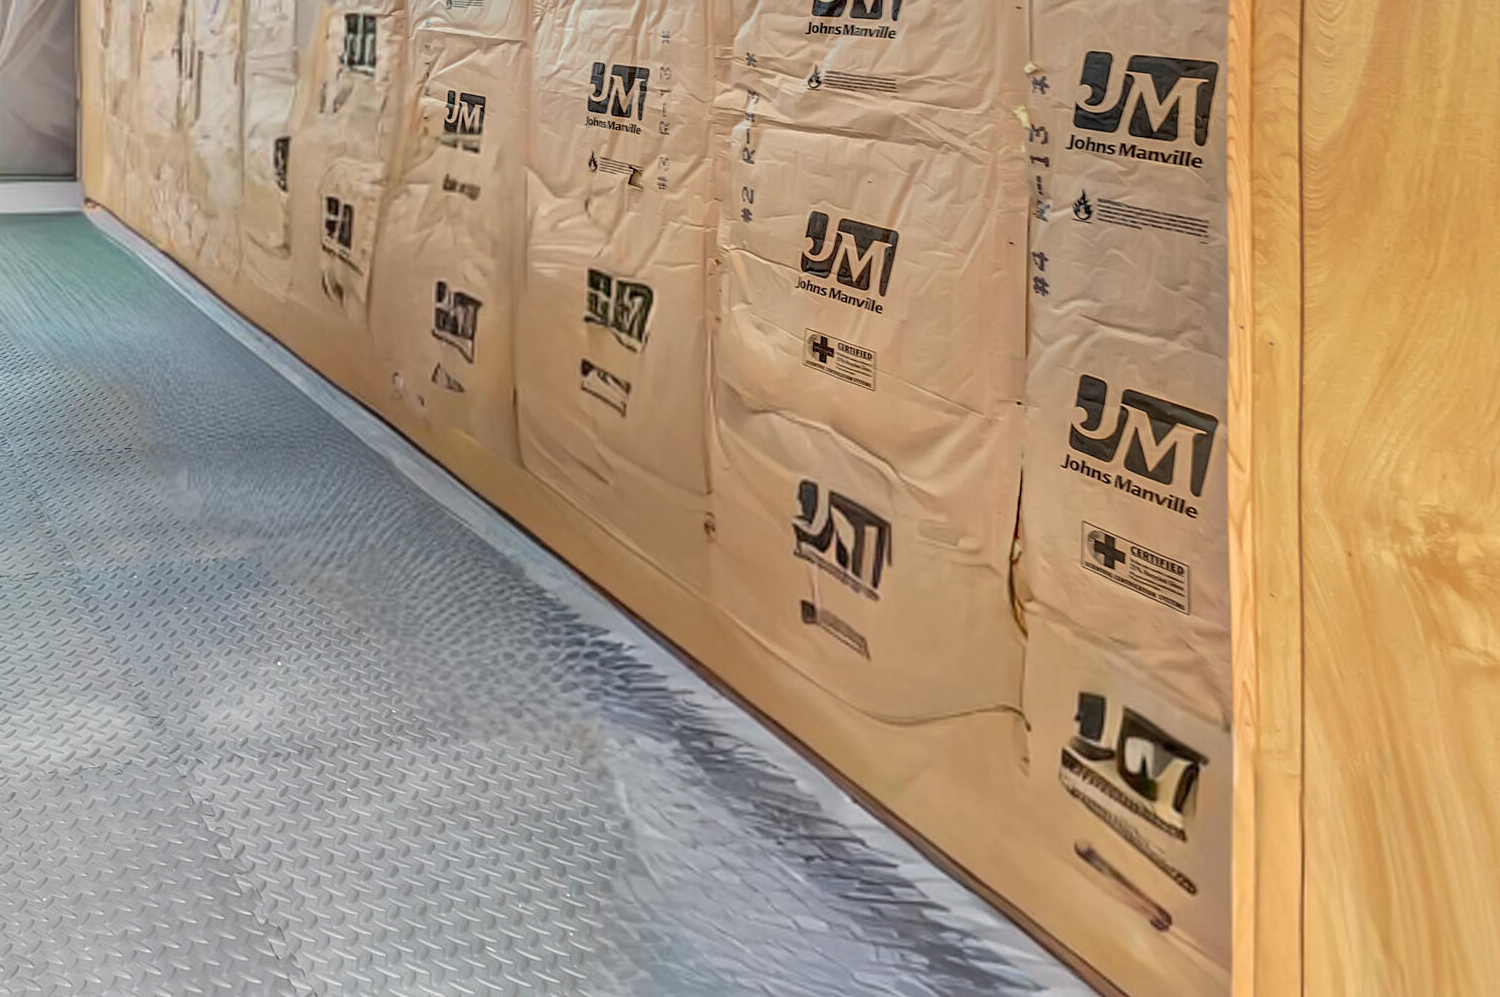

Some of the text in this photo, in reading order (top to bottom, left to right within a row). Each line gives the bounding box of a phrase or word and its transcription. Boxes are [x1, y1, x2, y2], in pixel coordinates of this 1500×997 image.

[805, 22, 897, 39] Johns Manville
[587, 62, 650, 121] JM
[1073, 51, 1219, 146] JM
[444, 90, 486, 135] JM
[585, 116, 607, 129] Johns
[1066, 134, 1204, 168] Johns Manville
[740, 186, 755, 223] #2
[801, 211, 899, 297] JM
[795, 276, 884, 314] Johns Manville
[837, 343, 873, 361] CERTIFIED
[1069, 374, 1219, 497] JM
[1060, 454, 1199, 519] Johns Manville
[1130, 545, 1185, 576] CERTIFIED
